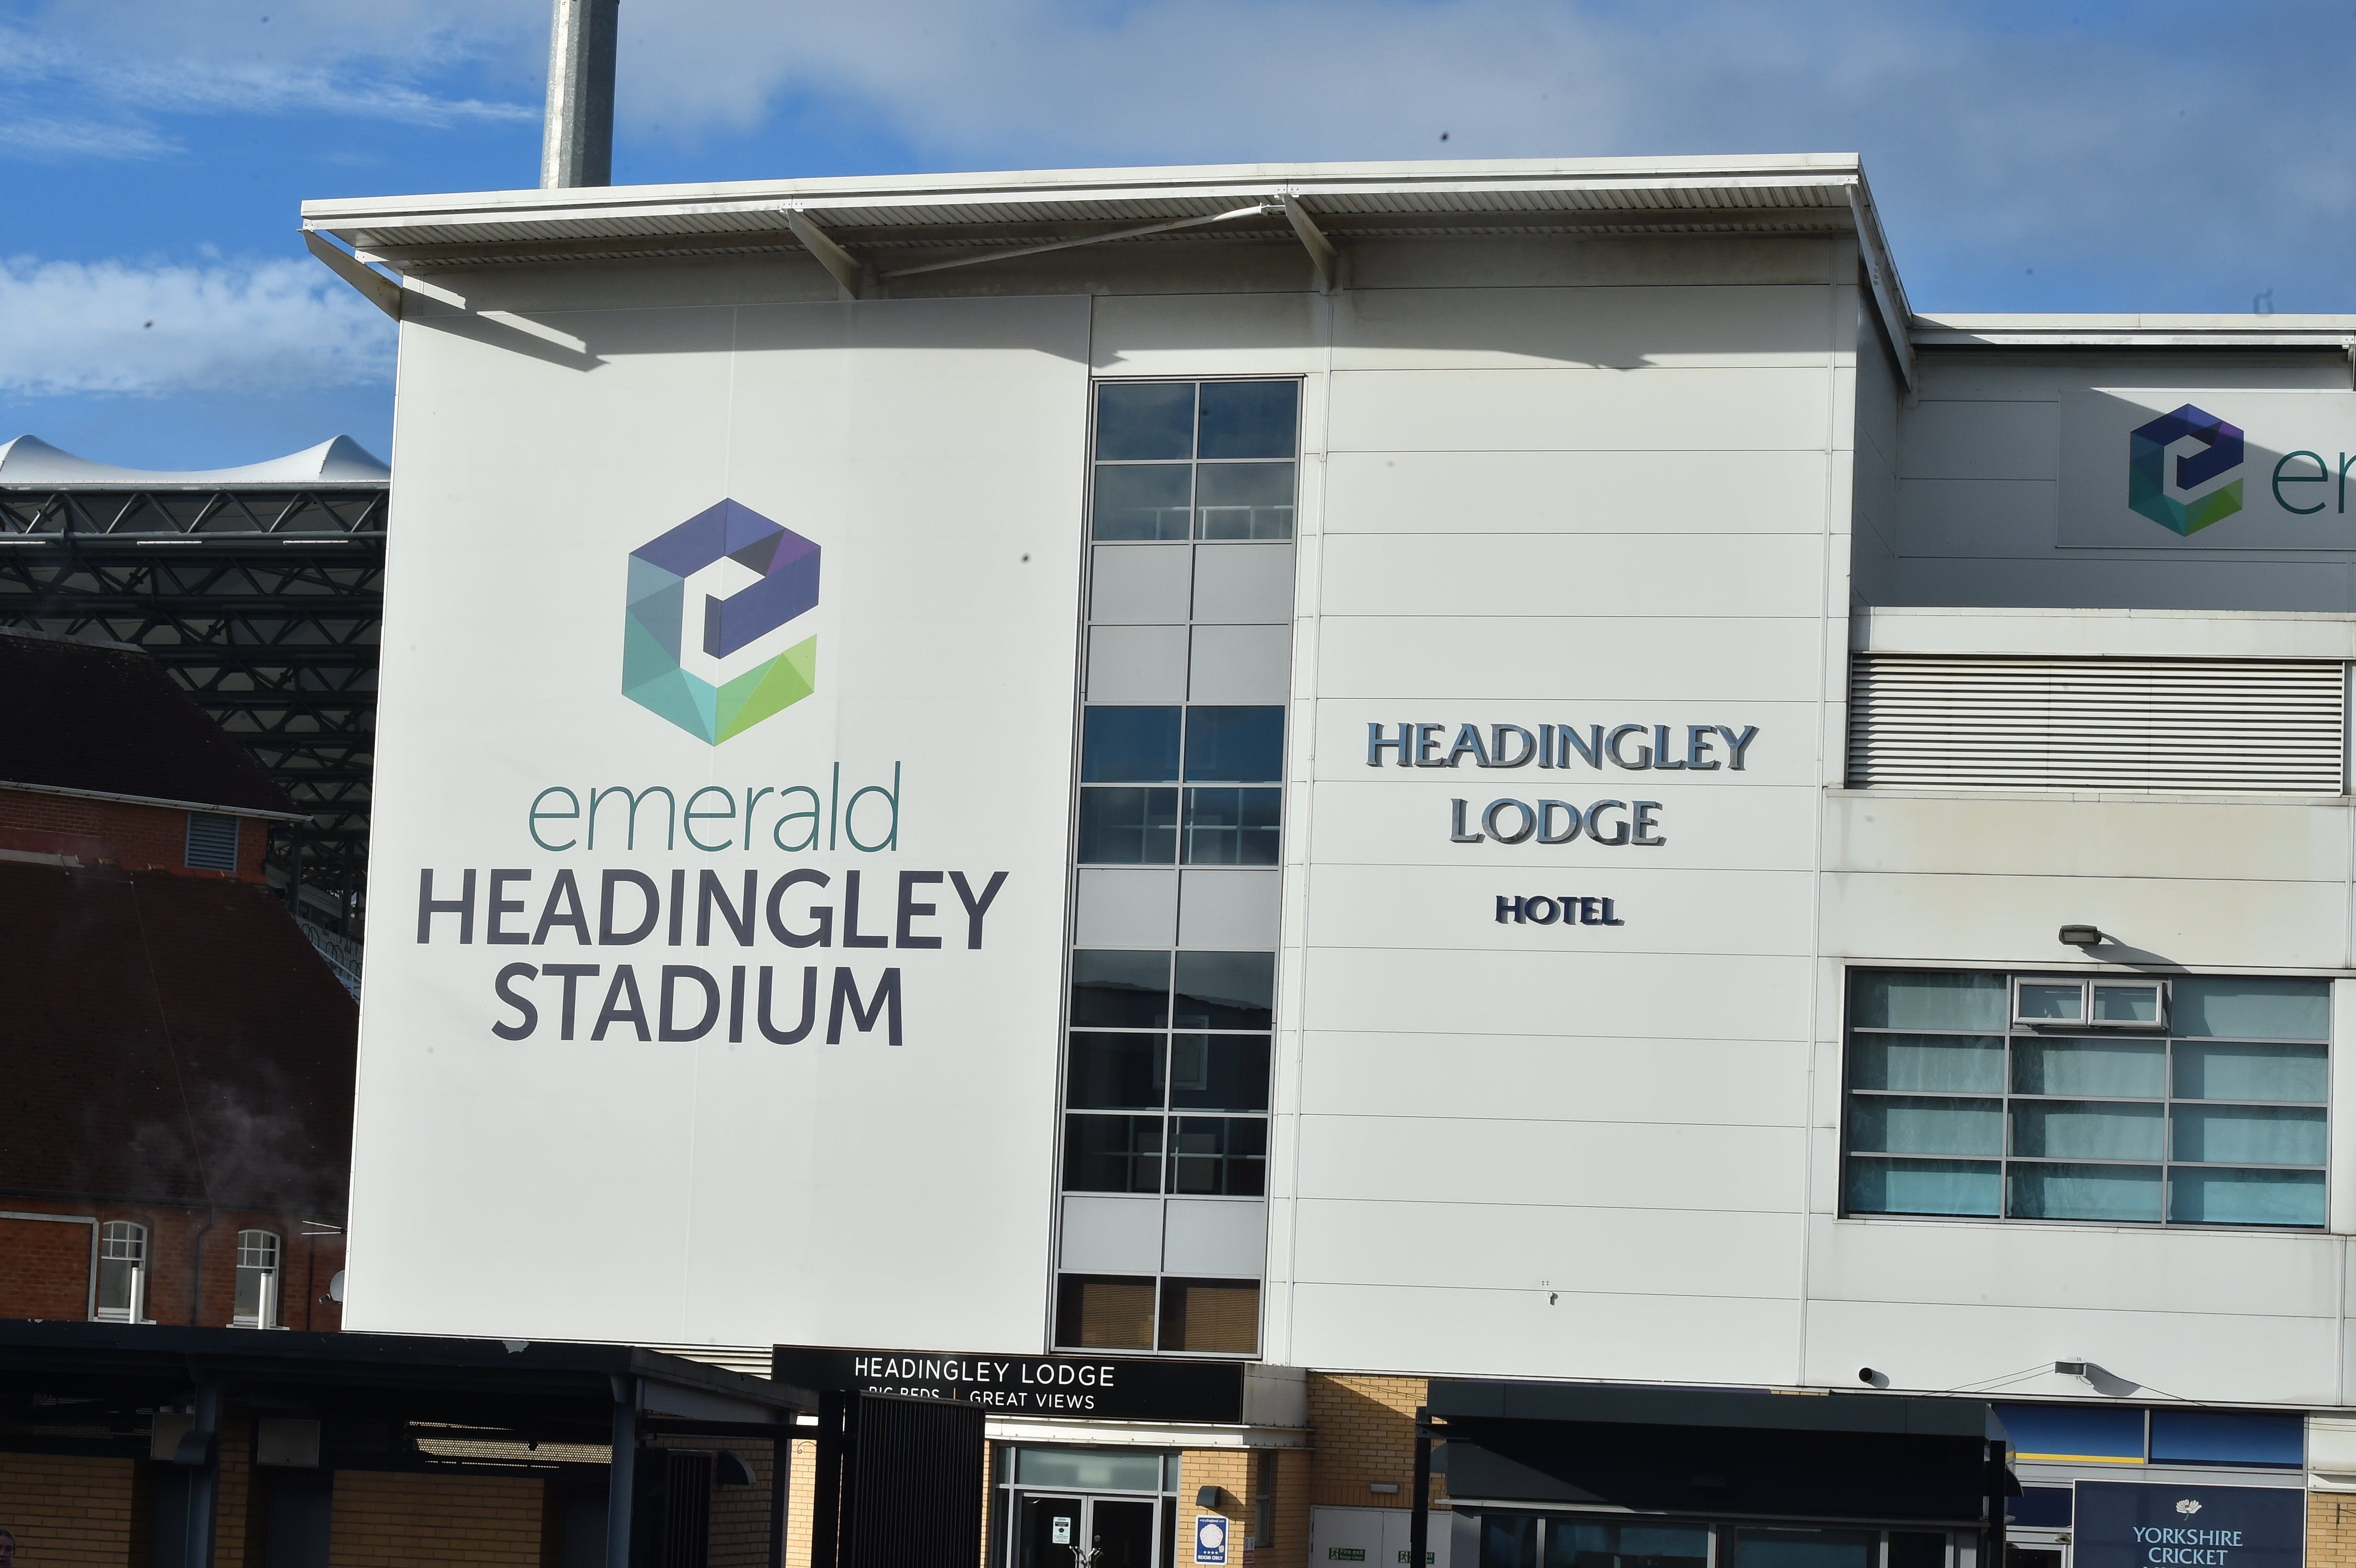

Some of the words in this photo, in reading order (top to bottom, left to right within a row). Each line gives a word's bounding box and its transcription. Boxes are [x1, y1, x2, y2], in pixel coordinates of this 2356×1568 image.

[1365, 722, 1760, 771] HEADINGLEY
[528, 761, 902, 853] emerald
[1449, 797, 1666, 846] LODGE
[416, 868, 1010, 950] HEADINGLEY
[1494, 895, 1624, 926] HOTEL
[491, 962, 903, 1046] STADIUM
[855, 1357, 1010, 1383] HEADINGLEY
[1022, 1363, 1115, 1387] LODGE
[970, 1391, 1028, 1406] GREAT
[1036, 1393, 1094, 1409] VIEWS
[2132, 1526, 2243, 1547] YORKSHIRE
[2148, 1547, 2228, 1566] CRICKET
